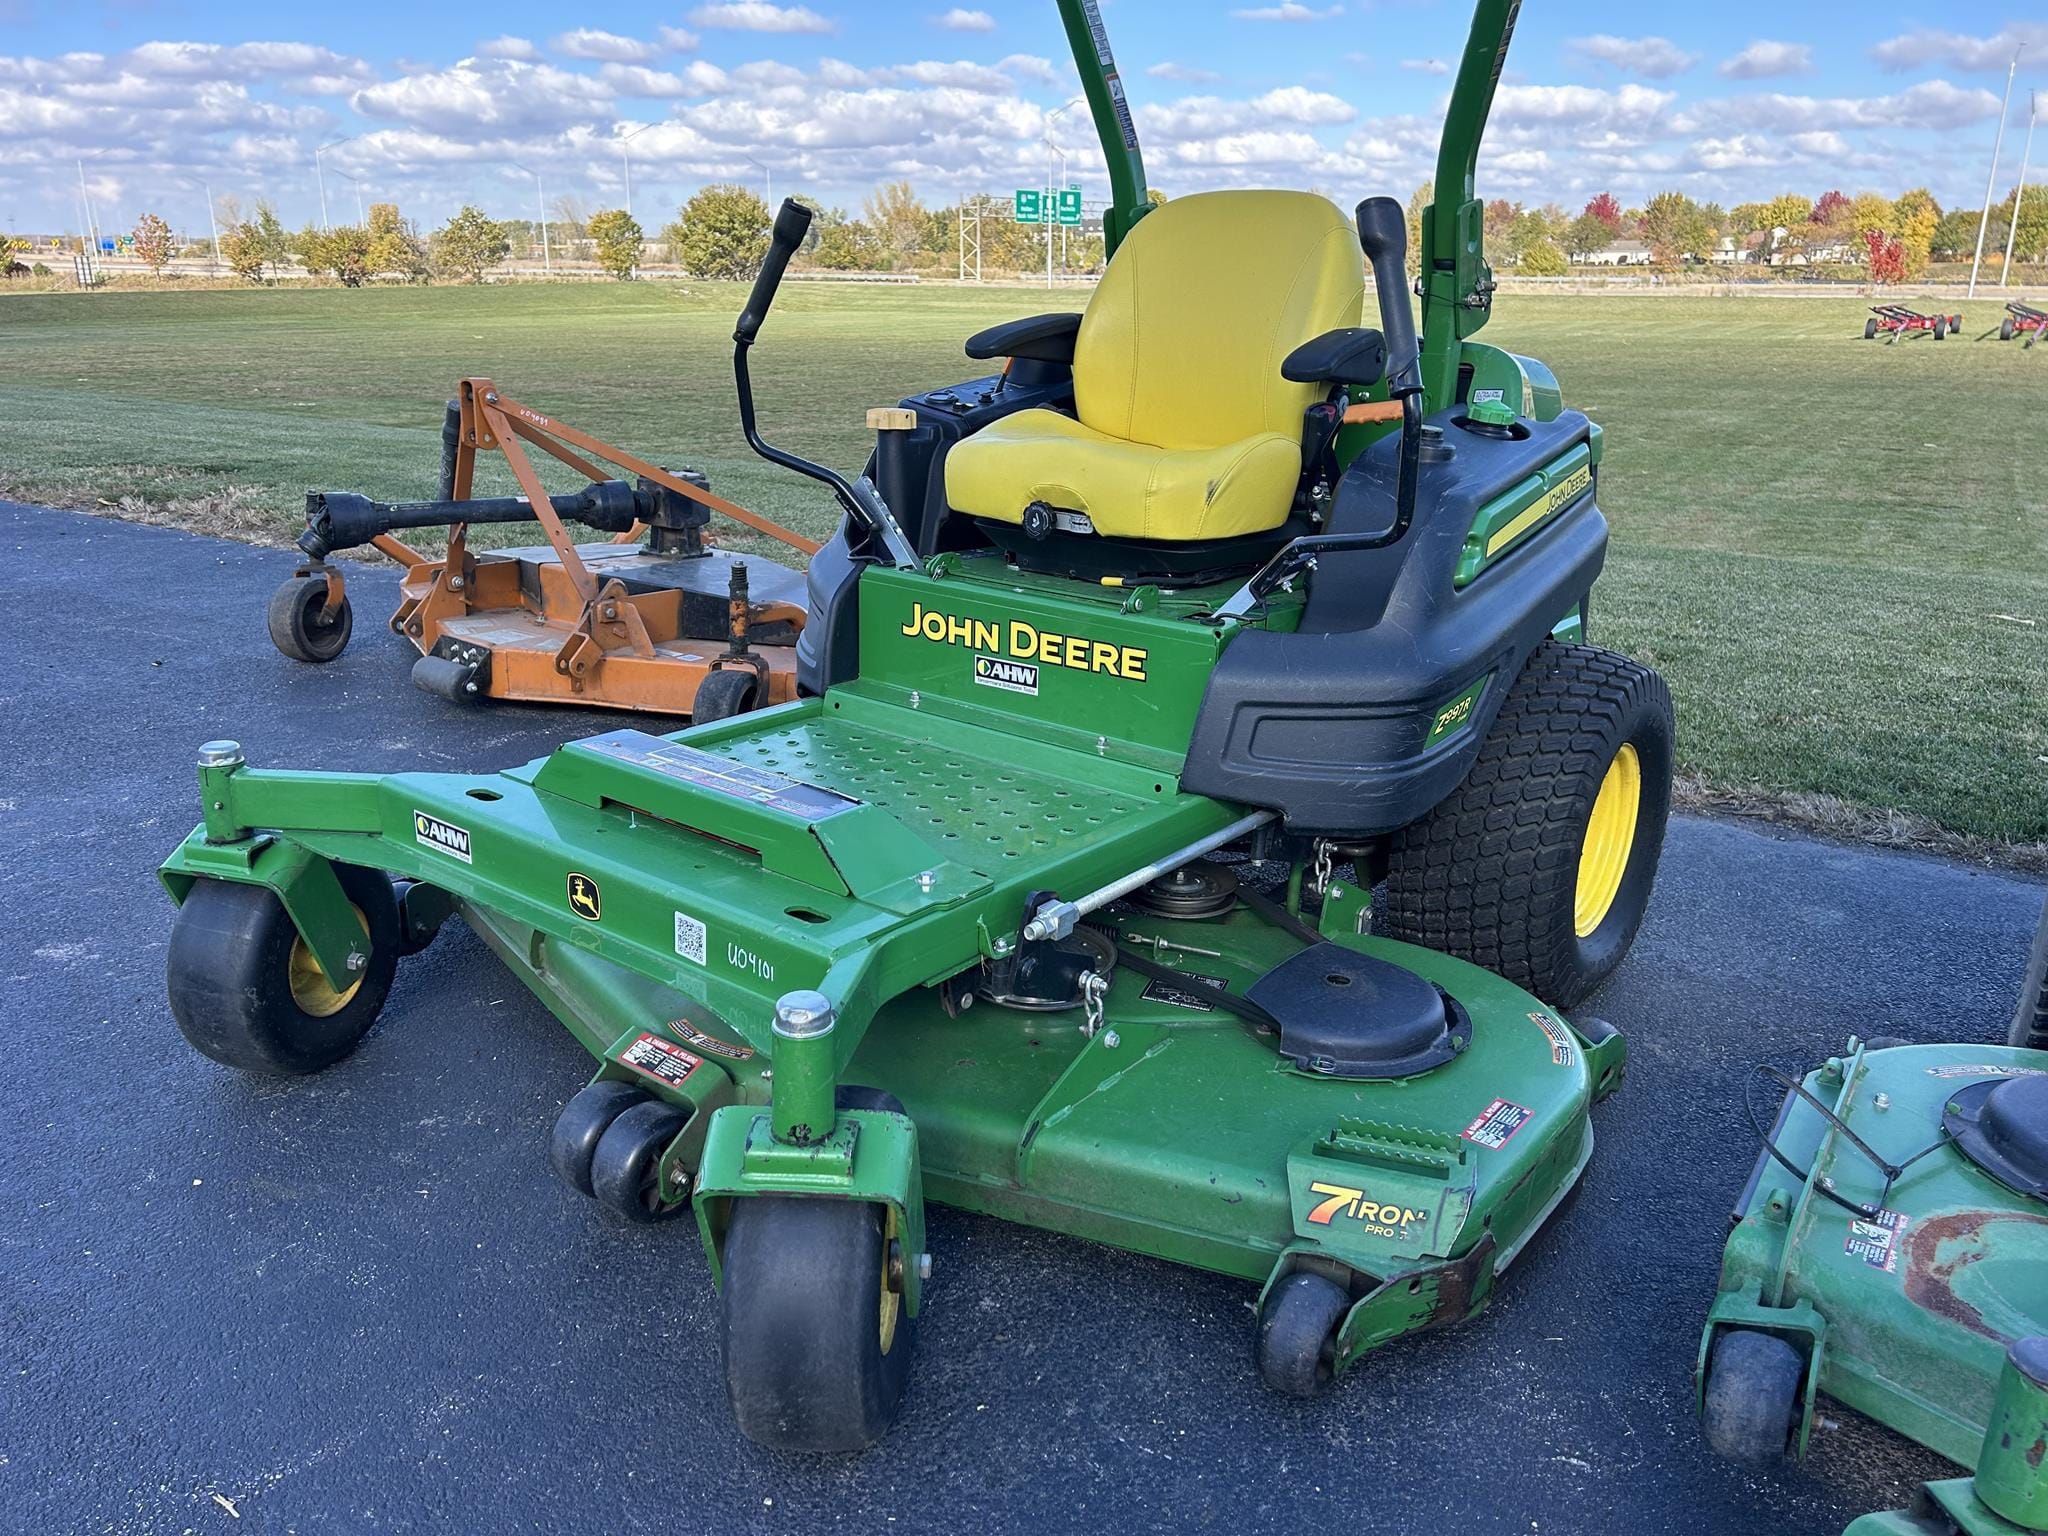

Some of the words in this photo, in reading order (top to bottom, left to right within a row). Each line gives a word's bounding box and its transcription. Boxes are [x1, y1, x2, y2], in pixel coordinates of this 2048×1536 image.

[1546, 485, 1566, 513] JOHN
[1566, 470, 1587, 496] DEERE
[902, 602, 1000, 653] JOHN
[1008, 619, 1148, 682] DEERE
[991, 664, 1036, 685] AHW
[1434, 696, 1471, 735] Z997R
[430, 822, 467, 851] AHW
[1364, 1224, 1395, 1238] PRO
